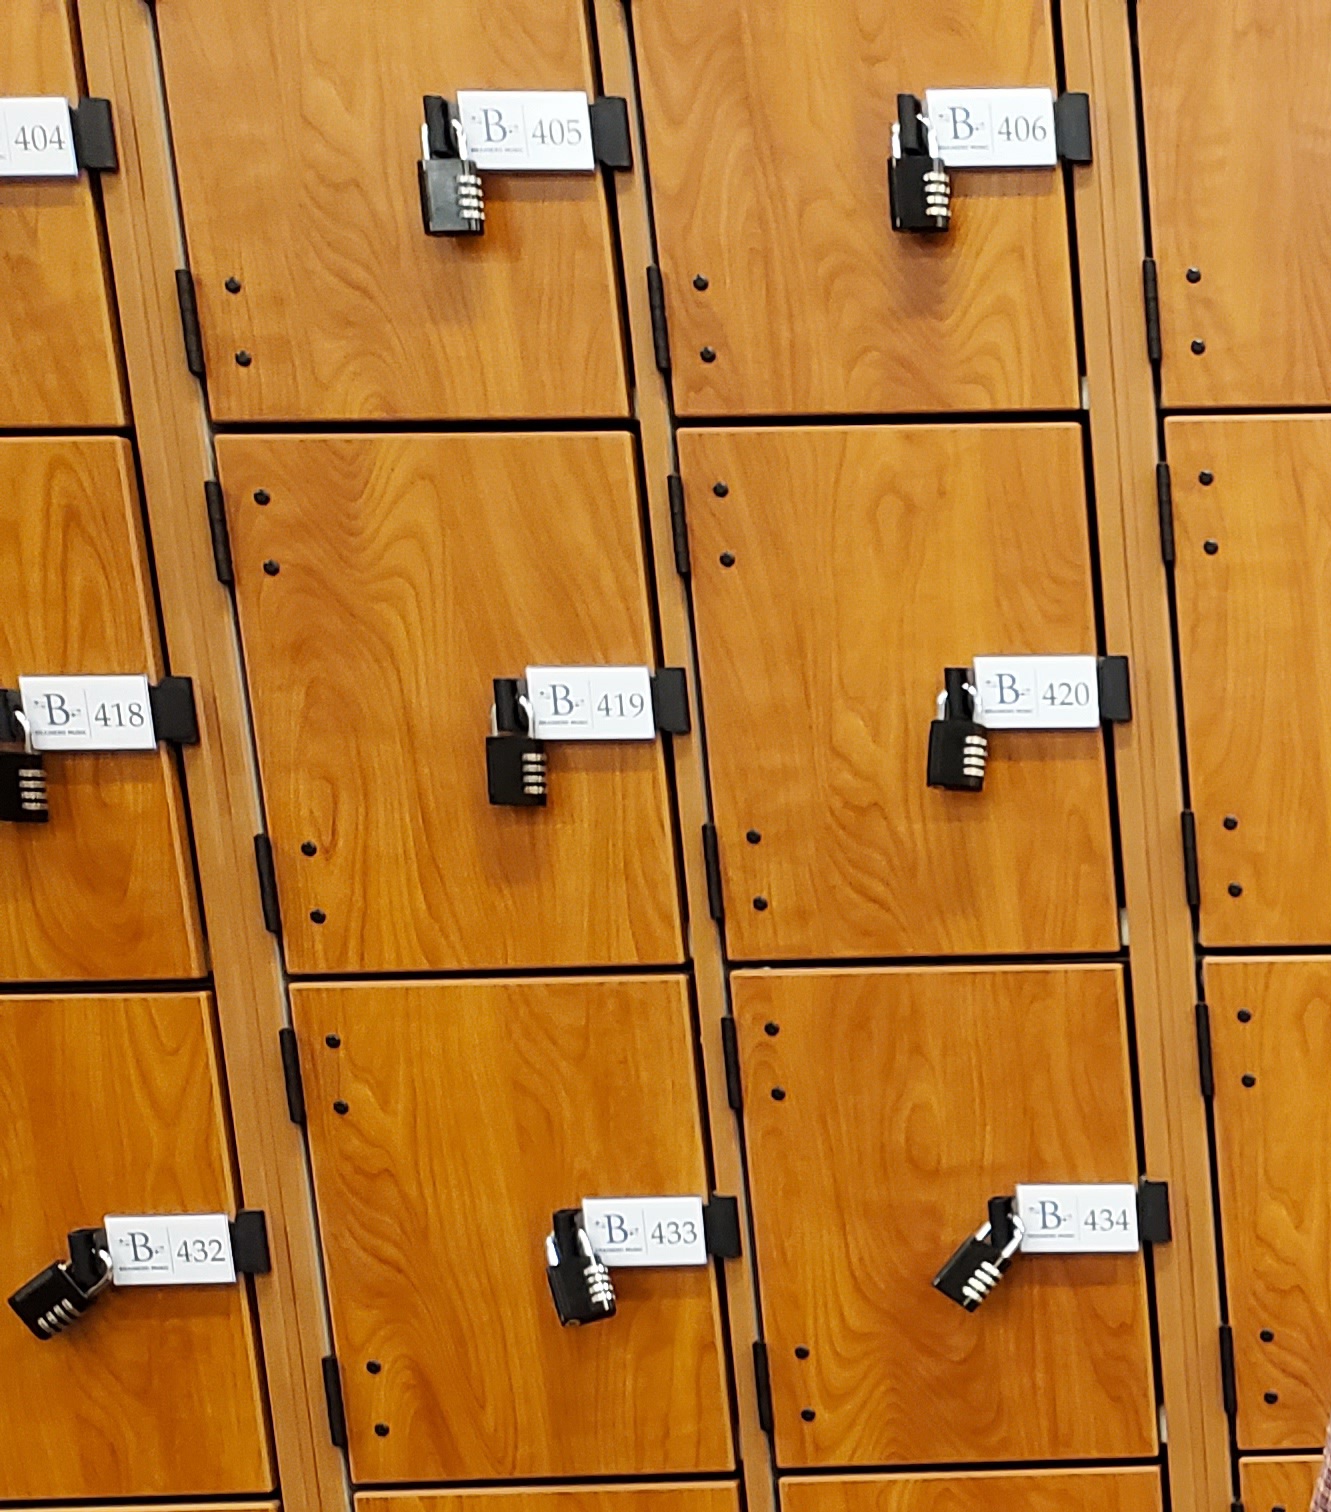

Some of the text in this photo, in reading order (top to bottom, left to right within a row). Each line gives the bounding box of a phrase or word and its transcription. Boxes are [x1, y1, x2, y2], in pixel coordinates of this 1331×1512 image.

[14, 125, 65, 151] 404
[482, 109, 582, 145] B 405
[952, 107, 1047, 141] B 406
[550, 684, 644, 717] B 419
[996, 674, 1089, 706] B 420
[43, 694, 144, 727] B 418
[604, 1214, 697, 1244] B 433
[1039, 1201, 1129, 1231] B 434
[128, 1232, 225, 1262] B 432
